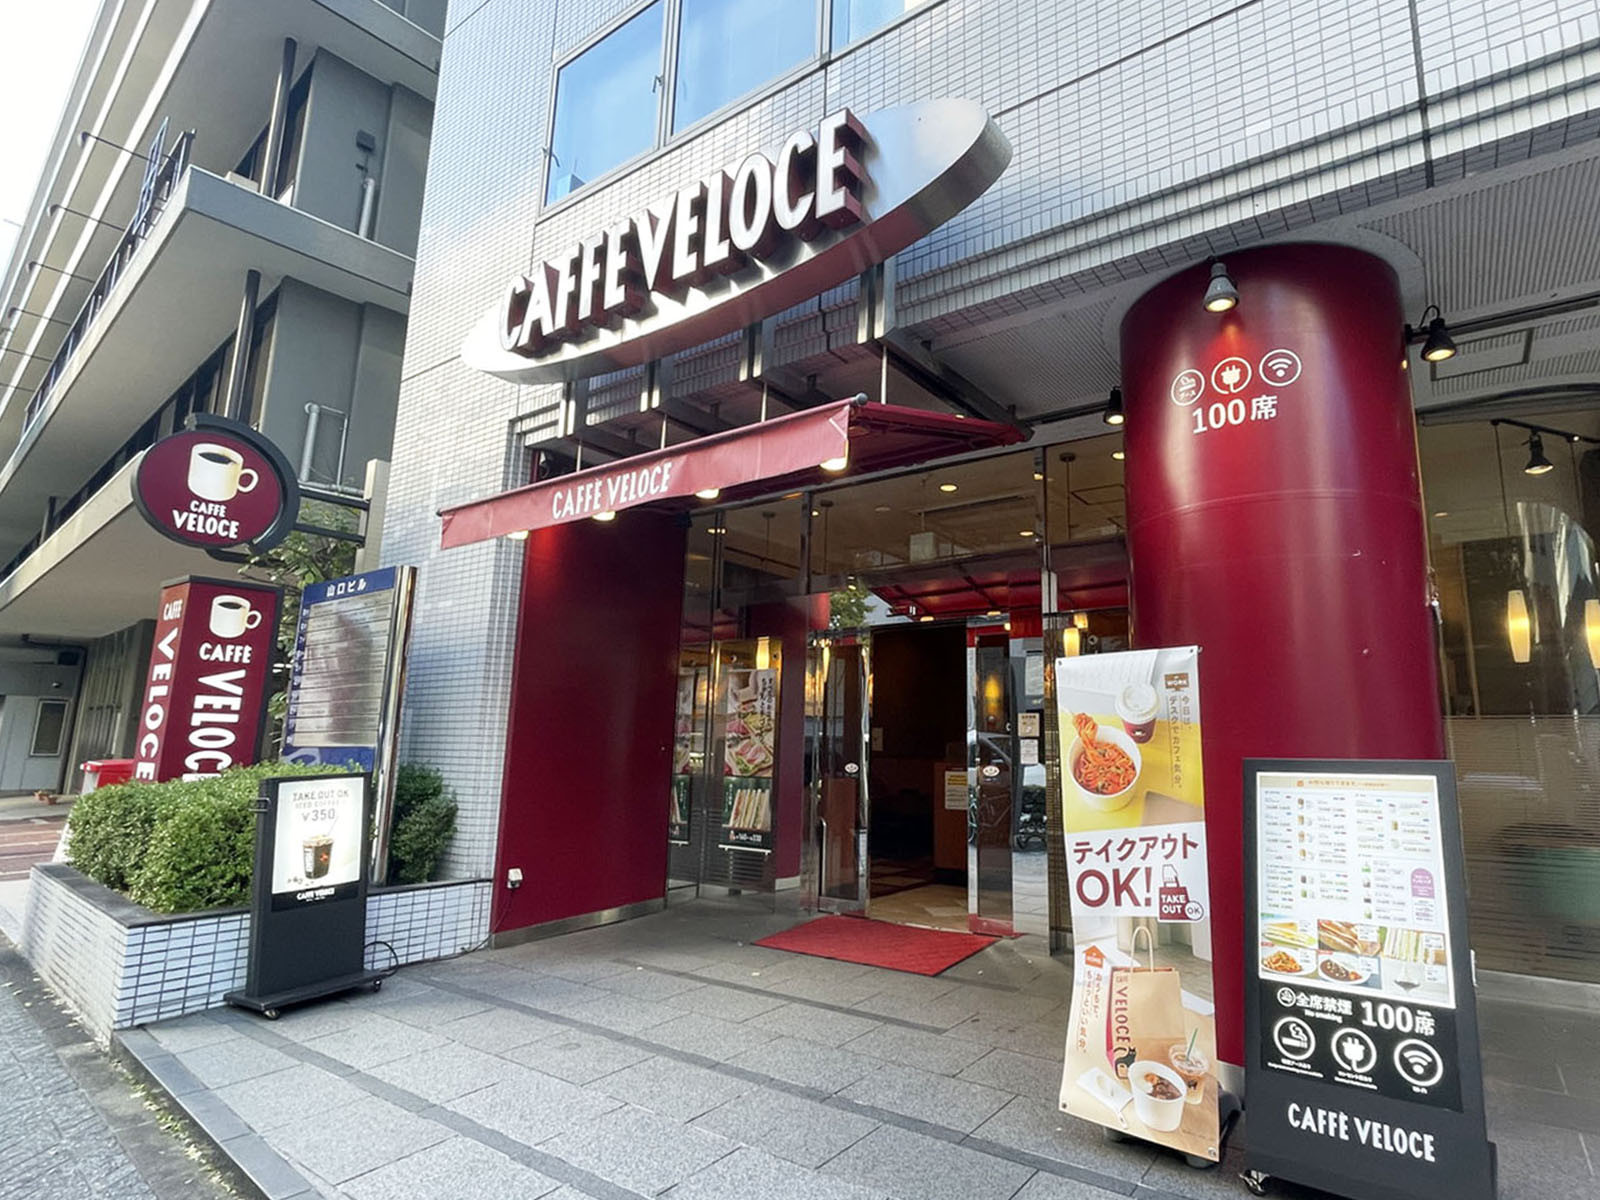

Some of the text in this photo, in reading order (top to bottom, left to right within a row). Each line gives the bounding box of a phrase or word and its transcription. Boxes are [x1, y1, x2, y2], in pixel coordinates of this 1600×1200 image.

[632, 108, 856, 291] VELOCE
[1192, 394, 1278, 434] 100席
[607, 462, 673, 507] VELOCE
[172, 509, 240, 539] VELOCE
[326, 578, 367, 597] 山口ビル
[136, 626, 179, 781] VELOCE
[293, 791, 317, 802] TAKE
[1073, 832, 1199, 865] テイクアウト
[1076, 866, 1152, 908] OK!
[1160, 894, 1186, 904] TAKE
[1161, 904, 1200, 915] OUT OK
[1114, 986, 1131, 1043] VELOCE
[1360, 1000, 1435, 1036] 100席
[1353, 1116, 1436, 1162] VELOCE
